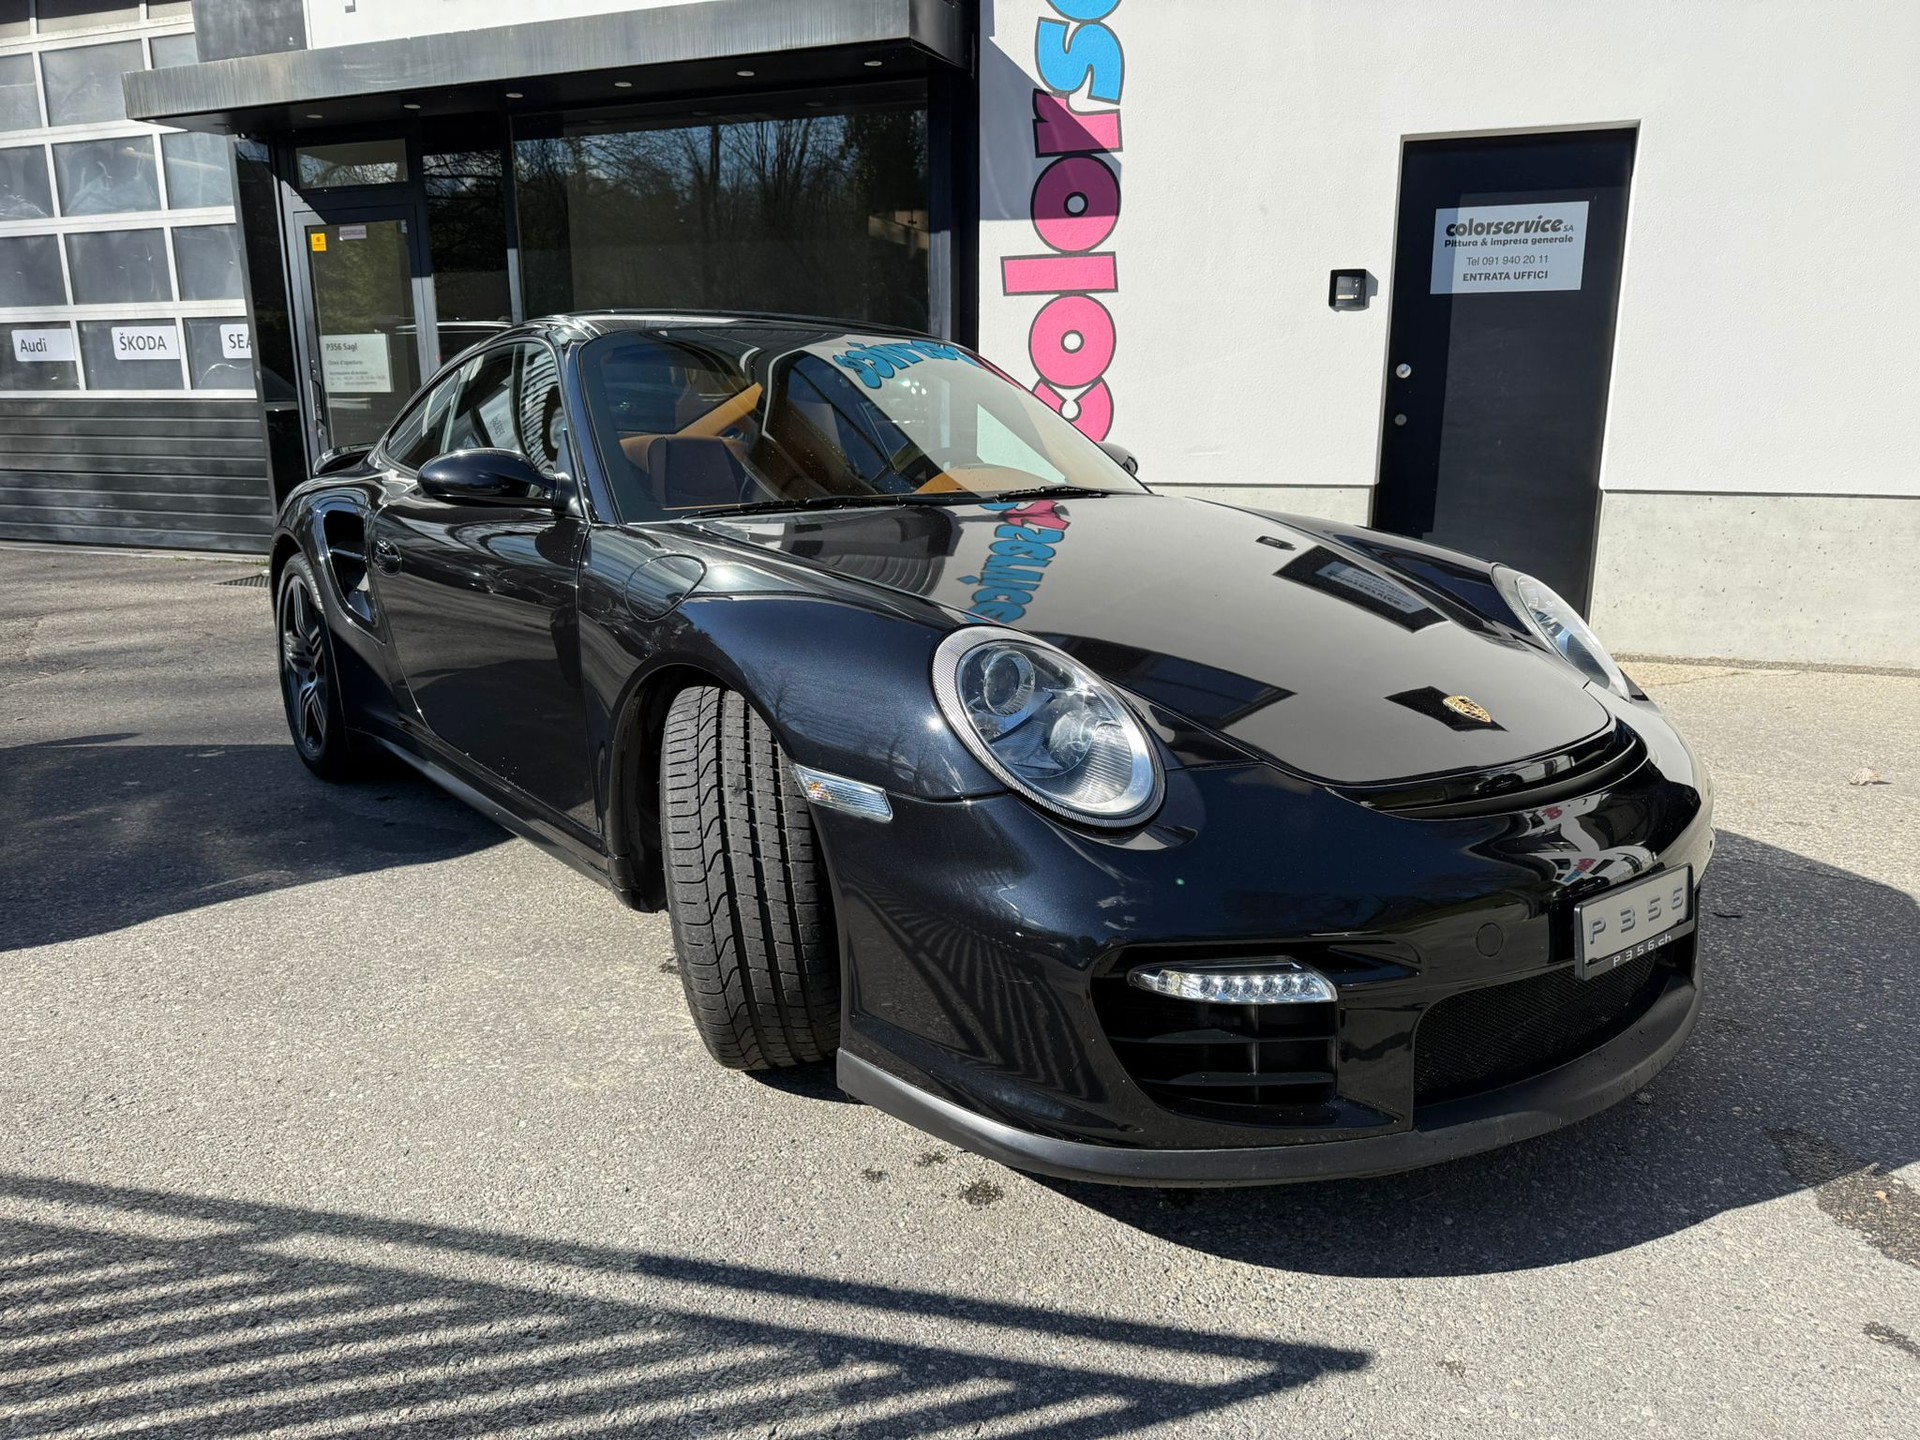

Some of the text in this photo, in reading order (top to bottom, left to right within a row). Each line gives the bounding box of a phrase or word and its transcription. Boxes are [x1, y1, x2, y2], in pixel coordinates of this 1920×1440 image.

[1000, 0, 1125, 442] colors
[1445, 215, 1574, 237] colorservice SA
[1444, 234, 1574, 248] Pittura & Impresa generale
[1466, 255, 1549, 266] Tel 091 940 20 11
[1463, 270, 1549, 282] ENTRATA UFFICI
[20, 338, 48, 353] Audi
[119, 332, 168, 351] ŠKODA
